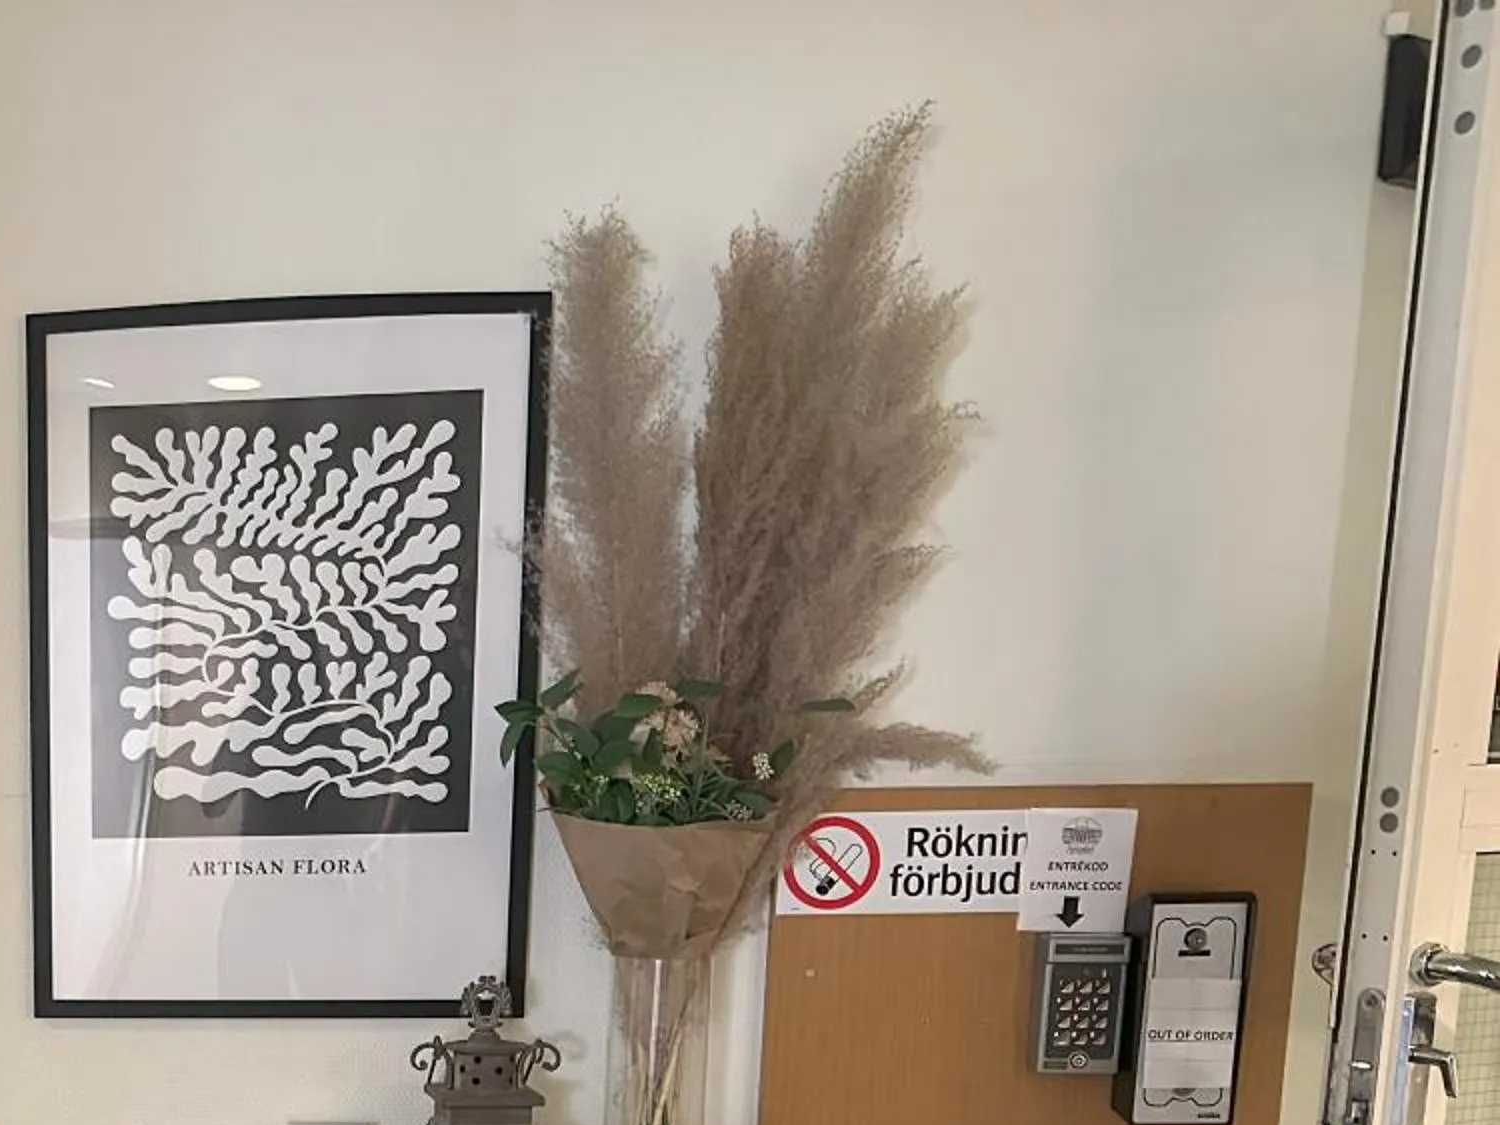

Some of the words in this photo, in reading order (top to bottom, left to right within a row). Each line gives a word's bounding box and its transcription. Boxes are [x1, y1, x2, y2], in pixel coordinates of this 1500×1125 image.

[906, 823, 1028, 858] Röknin
[188, 859, 285, 877] ARTISAN
[293, 858, 367, 875] FLORA
[889, 861, 1022, 903] förbjud
[1029, 880, 1089, 892] ENTRANCE
[1091, 881, 1124, 892] CODE
[1147, 1029, 1173, 1040] OUT
[1175, 1029, 1192, 1041] OF
[1193, 1030, 1234, 1041] ORDER
